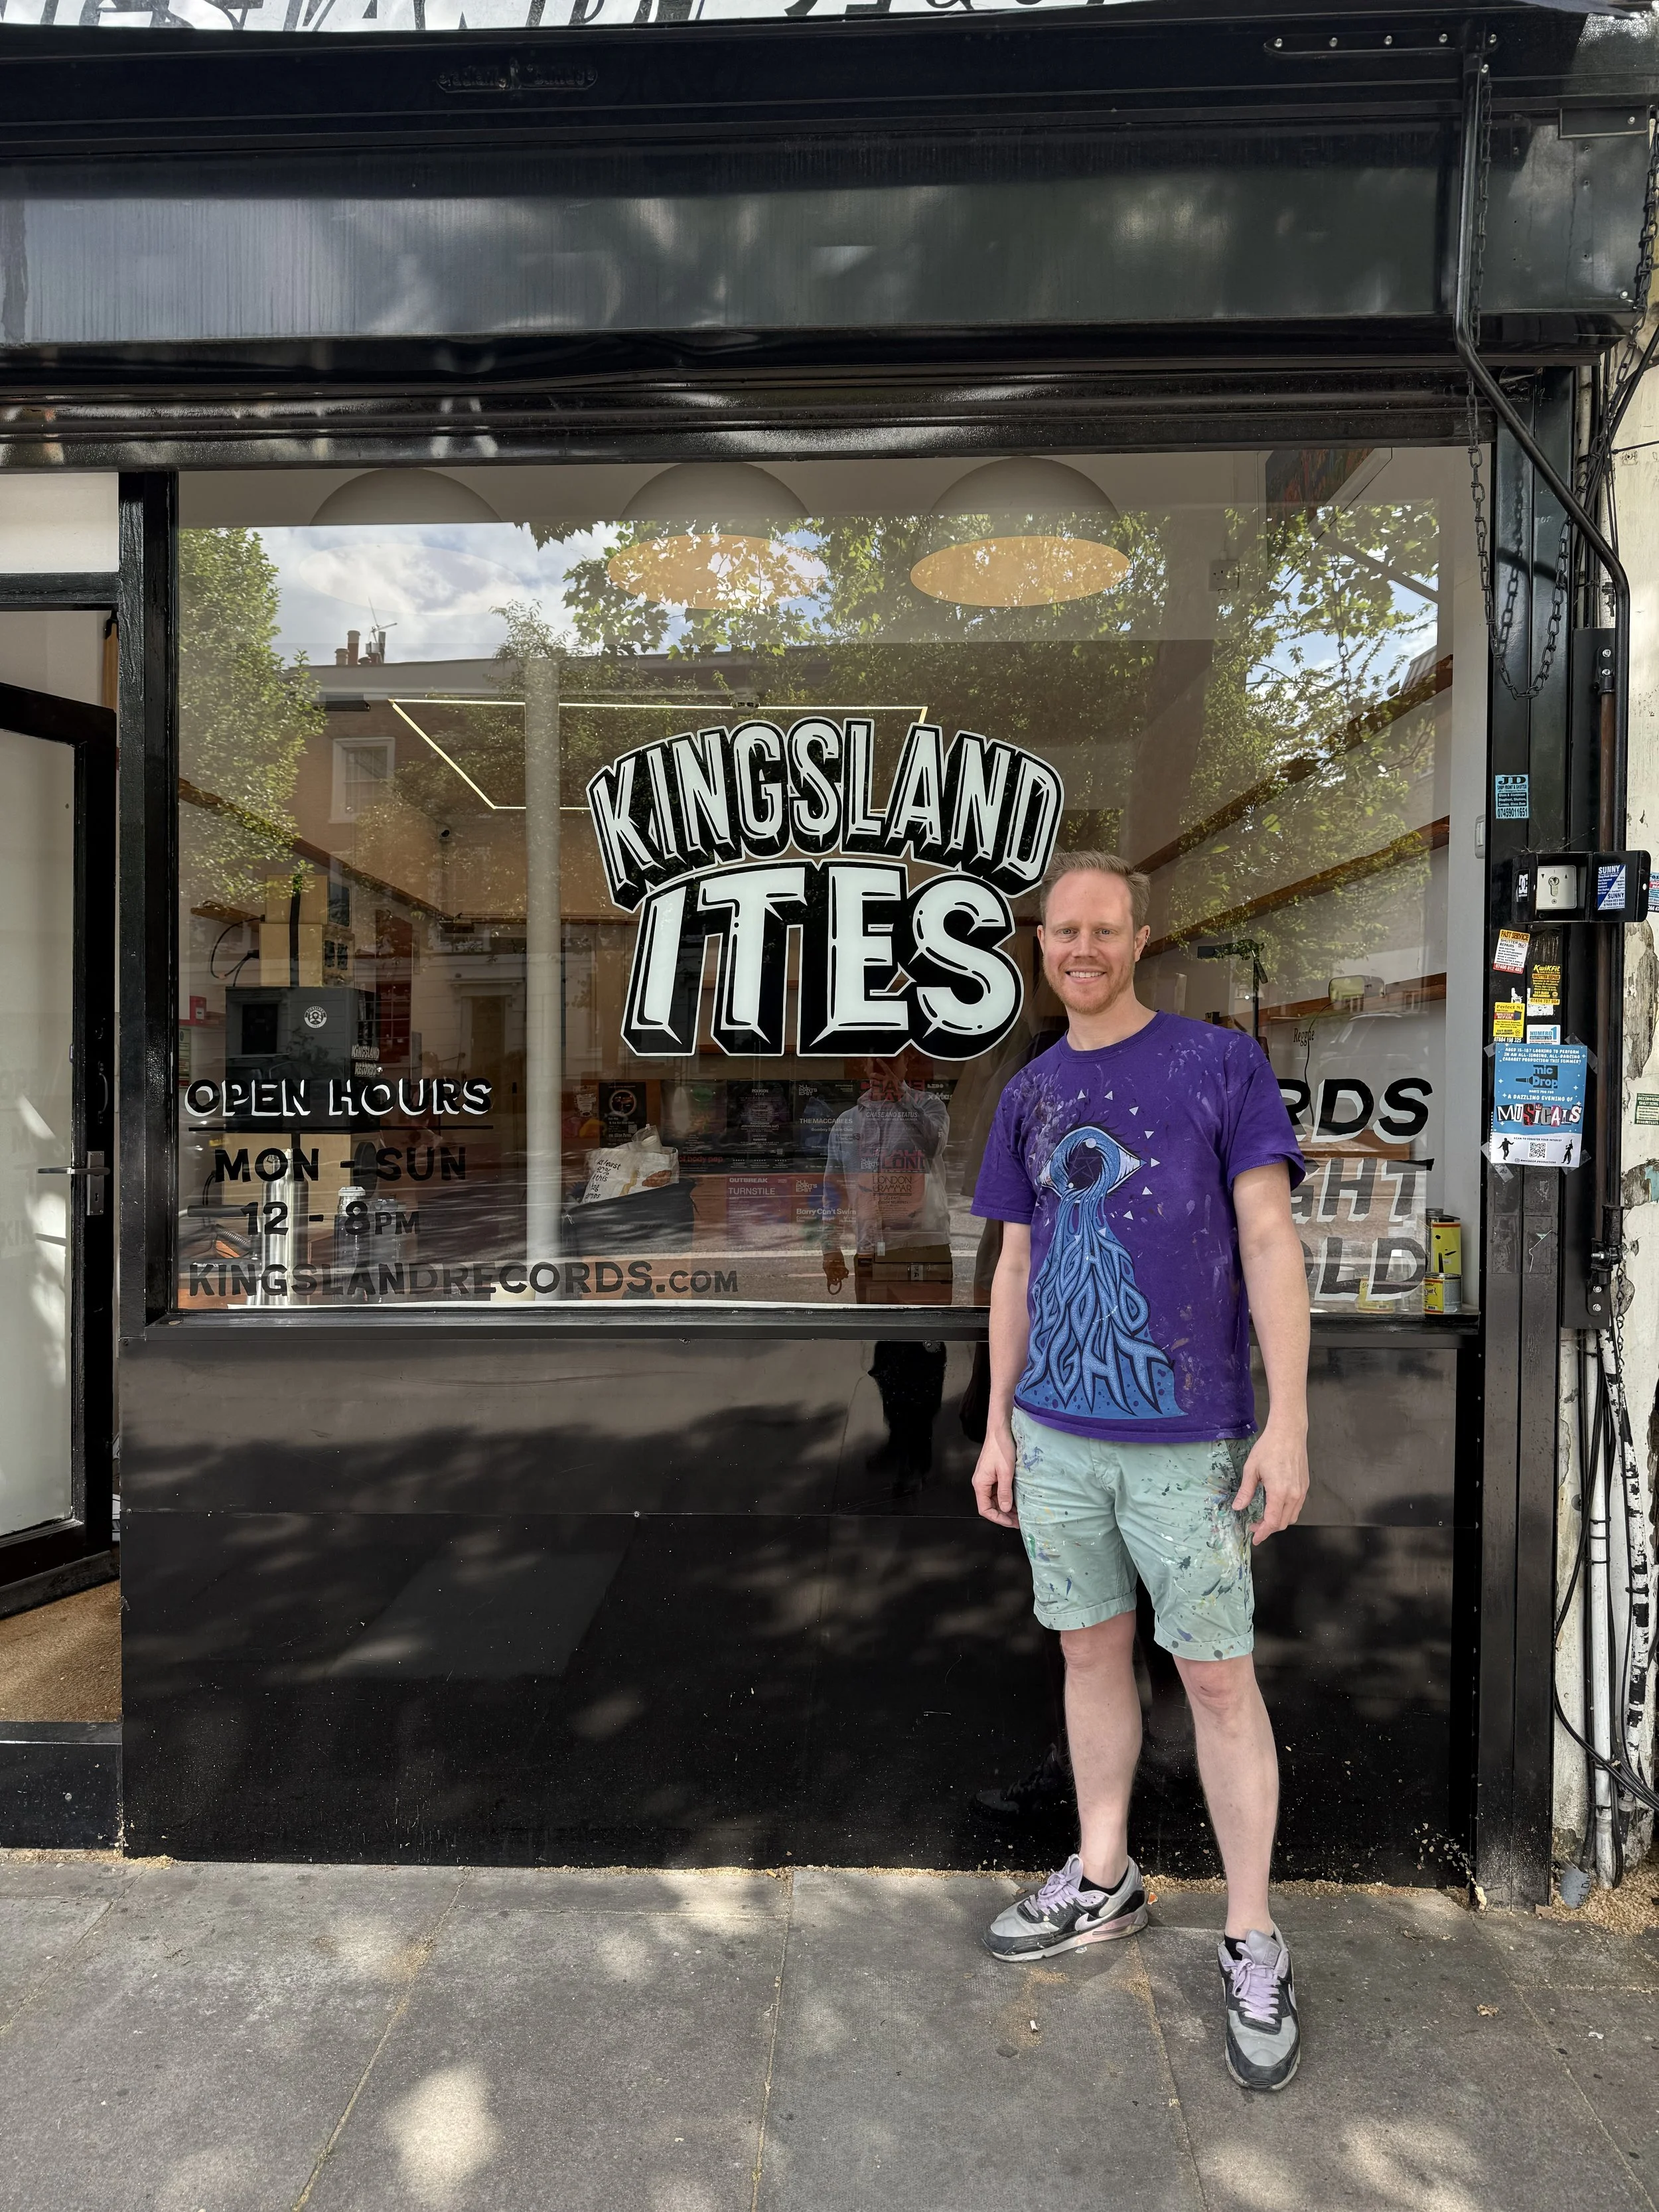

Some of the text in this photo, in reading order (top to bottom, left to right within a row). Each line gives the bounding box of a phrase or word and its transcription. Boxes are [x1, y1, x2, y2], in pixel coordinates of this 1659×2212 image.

[586, 717, 1063, 913] KINGSLAND
[1598, 865, 1620, 874] SUNNY
[1512, 932, 1529, 941] SERVICE
[621, 859, 1023, 1061] ITES
[1534, 1066, 1553, 1074] mic
[1533, 1076, 1558, 1088] Drop
[184, 1078, 492, 1116] OPEN HOURS
[1496, 1104, 1583, 1126] MUSICALS
[215, 1148, 319, 1182] MON
[376, 1147, 466, 1181] SUN
[604, 1159, 621, 1170] least
[873, 1184, 912, 1193] GRAMMAR
[240, 1201, 289, 1235] 12
[346, 1201, 420, 1235] 8PM
[188, 1262, 739, 1297] KINGSLANDRECORDS.COM
